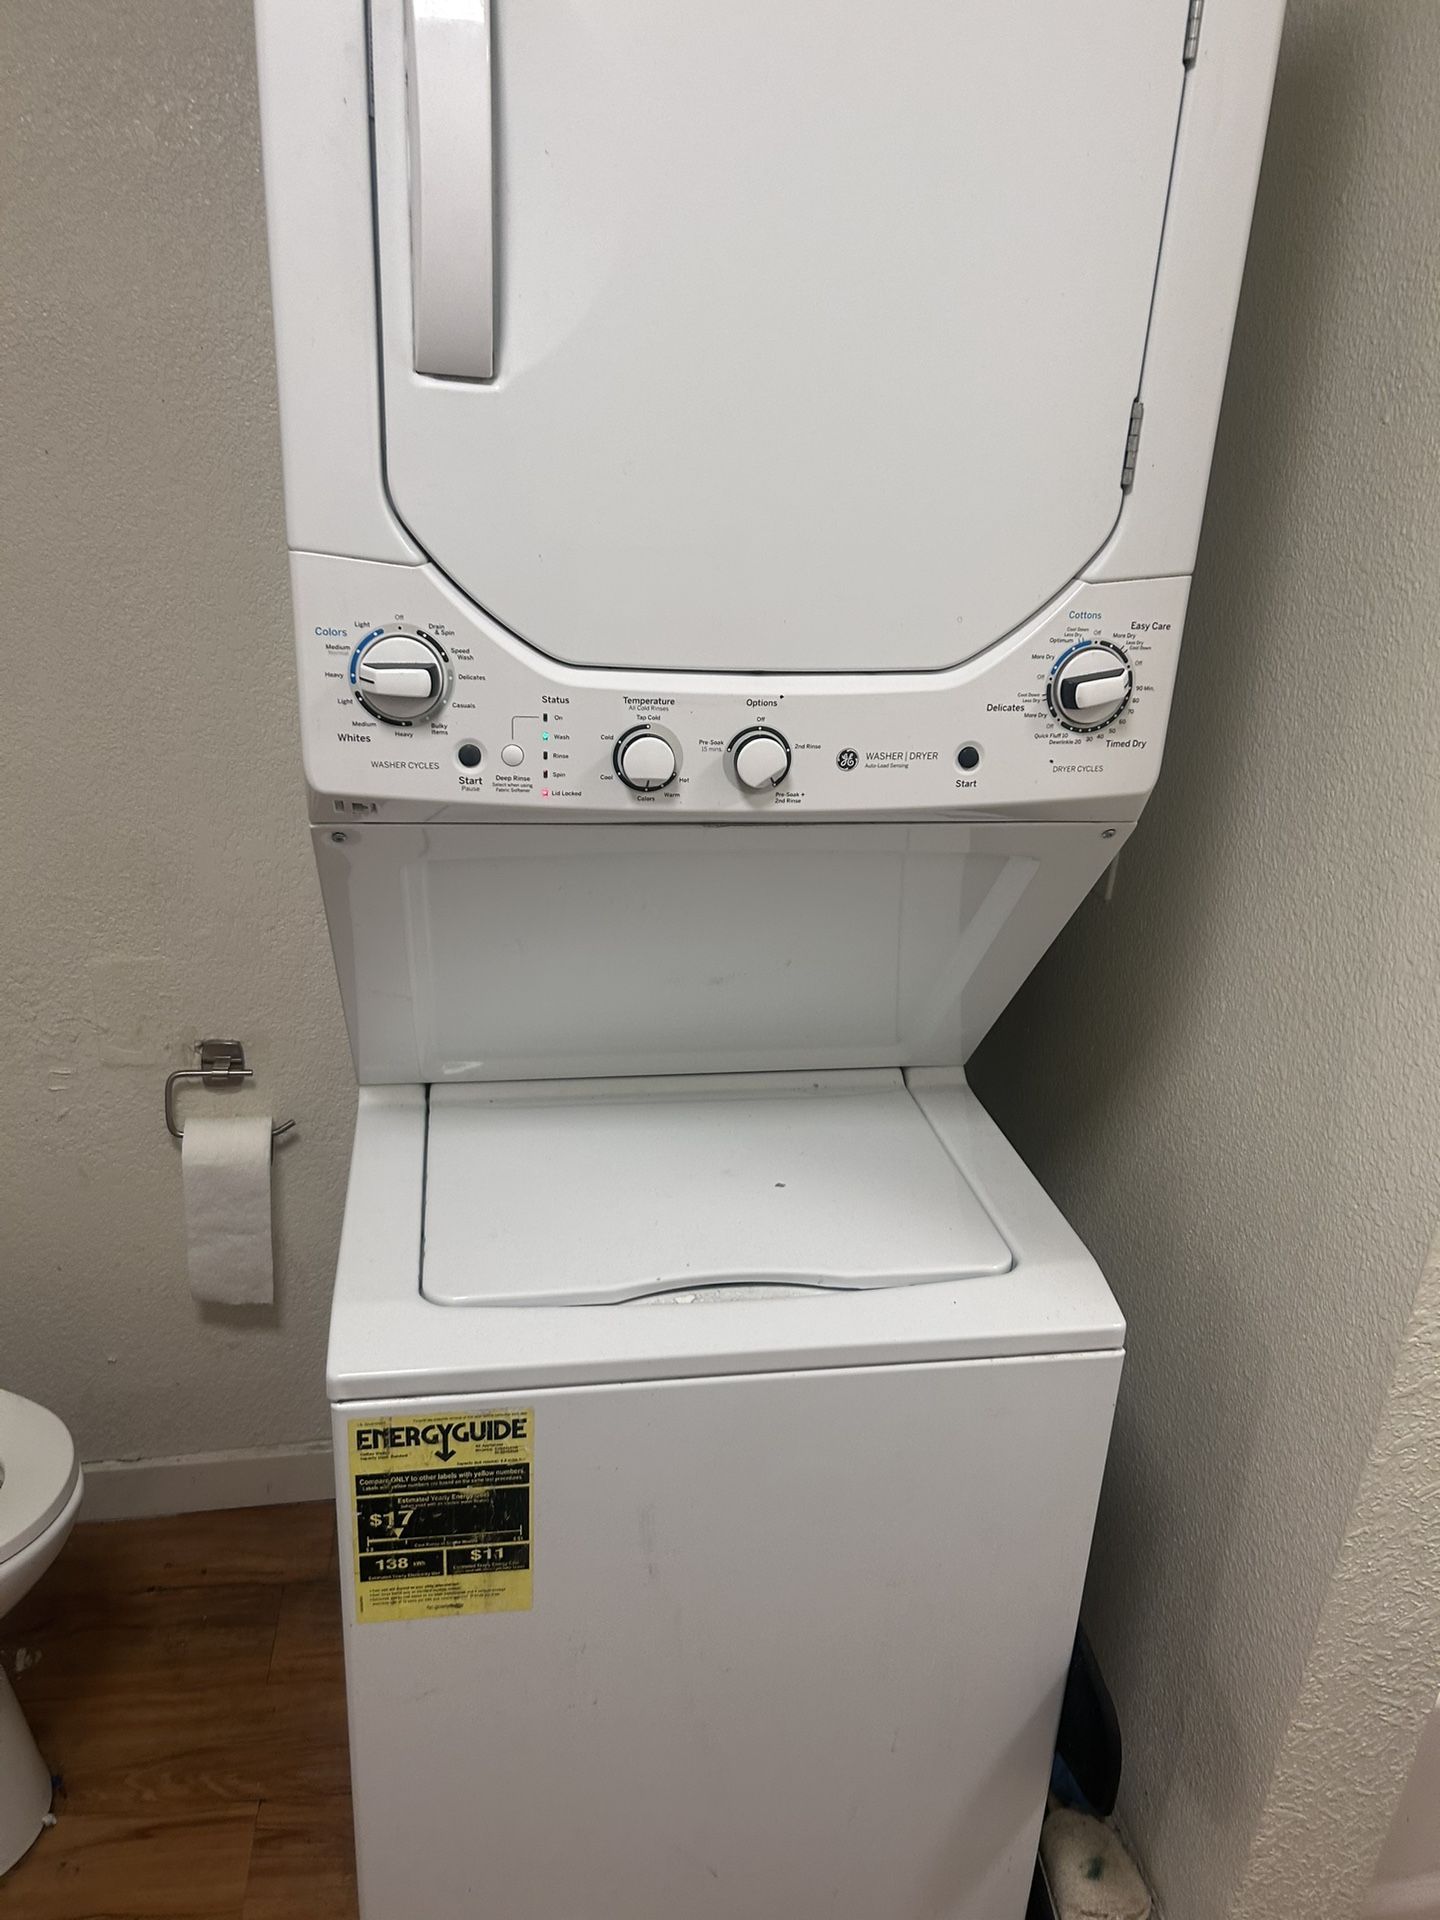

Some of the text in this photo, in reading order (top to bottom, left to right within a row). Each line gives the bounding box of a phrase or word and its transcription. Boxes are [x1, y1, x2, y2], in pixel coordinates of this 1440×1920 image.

[1069, 611, 1102, 620] Cottons
[354, 621, 370, 629] Light
[1131, 622, 1171, 631] Easy Care
[315, 627, 347, 637] Colors
[542, 696, 570, 704] Status
[623, 696, 675, 706] Temperature
[746, 699, 778, 708] Options
[987, 704, 1025, 713] Delicates
[338, 733, 371, 742] Whites
[1132, 740, 1147, 749] Dry
[866, 752, 939, 760] WASHER DRYER
[371, 761, 439, 770] WASHER CYCLES
[1077, 765, 1104, 773] CYCLES
[459, 776, 483, 785] Start
[956, 780, 977, 788] Start
[357, 1419, 527, 1454] ENERGYGUIDE
[391, 1475, 410, 1484] ONLY
[419, 1473, 437, 1482] other
[438, 1471, 458, 1480] labels
[459, 1470, 473, 1479] with
[474, 1469, 494, 1479] yellow
[398, 1496, 430, 1505] Estimated
[431, 1494, 450, 1504] Yearly
[452, 1491, 475, 1502] Energy
[370, 1510, 414, 1528] $17
[471, 1547, 504, 1561] $11
[376, 1557, 409, 1571] 138
